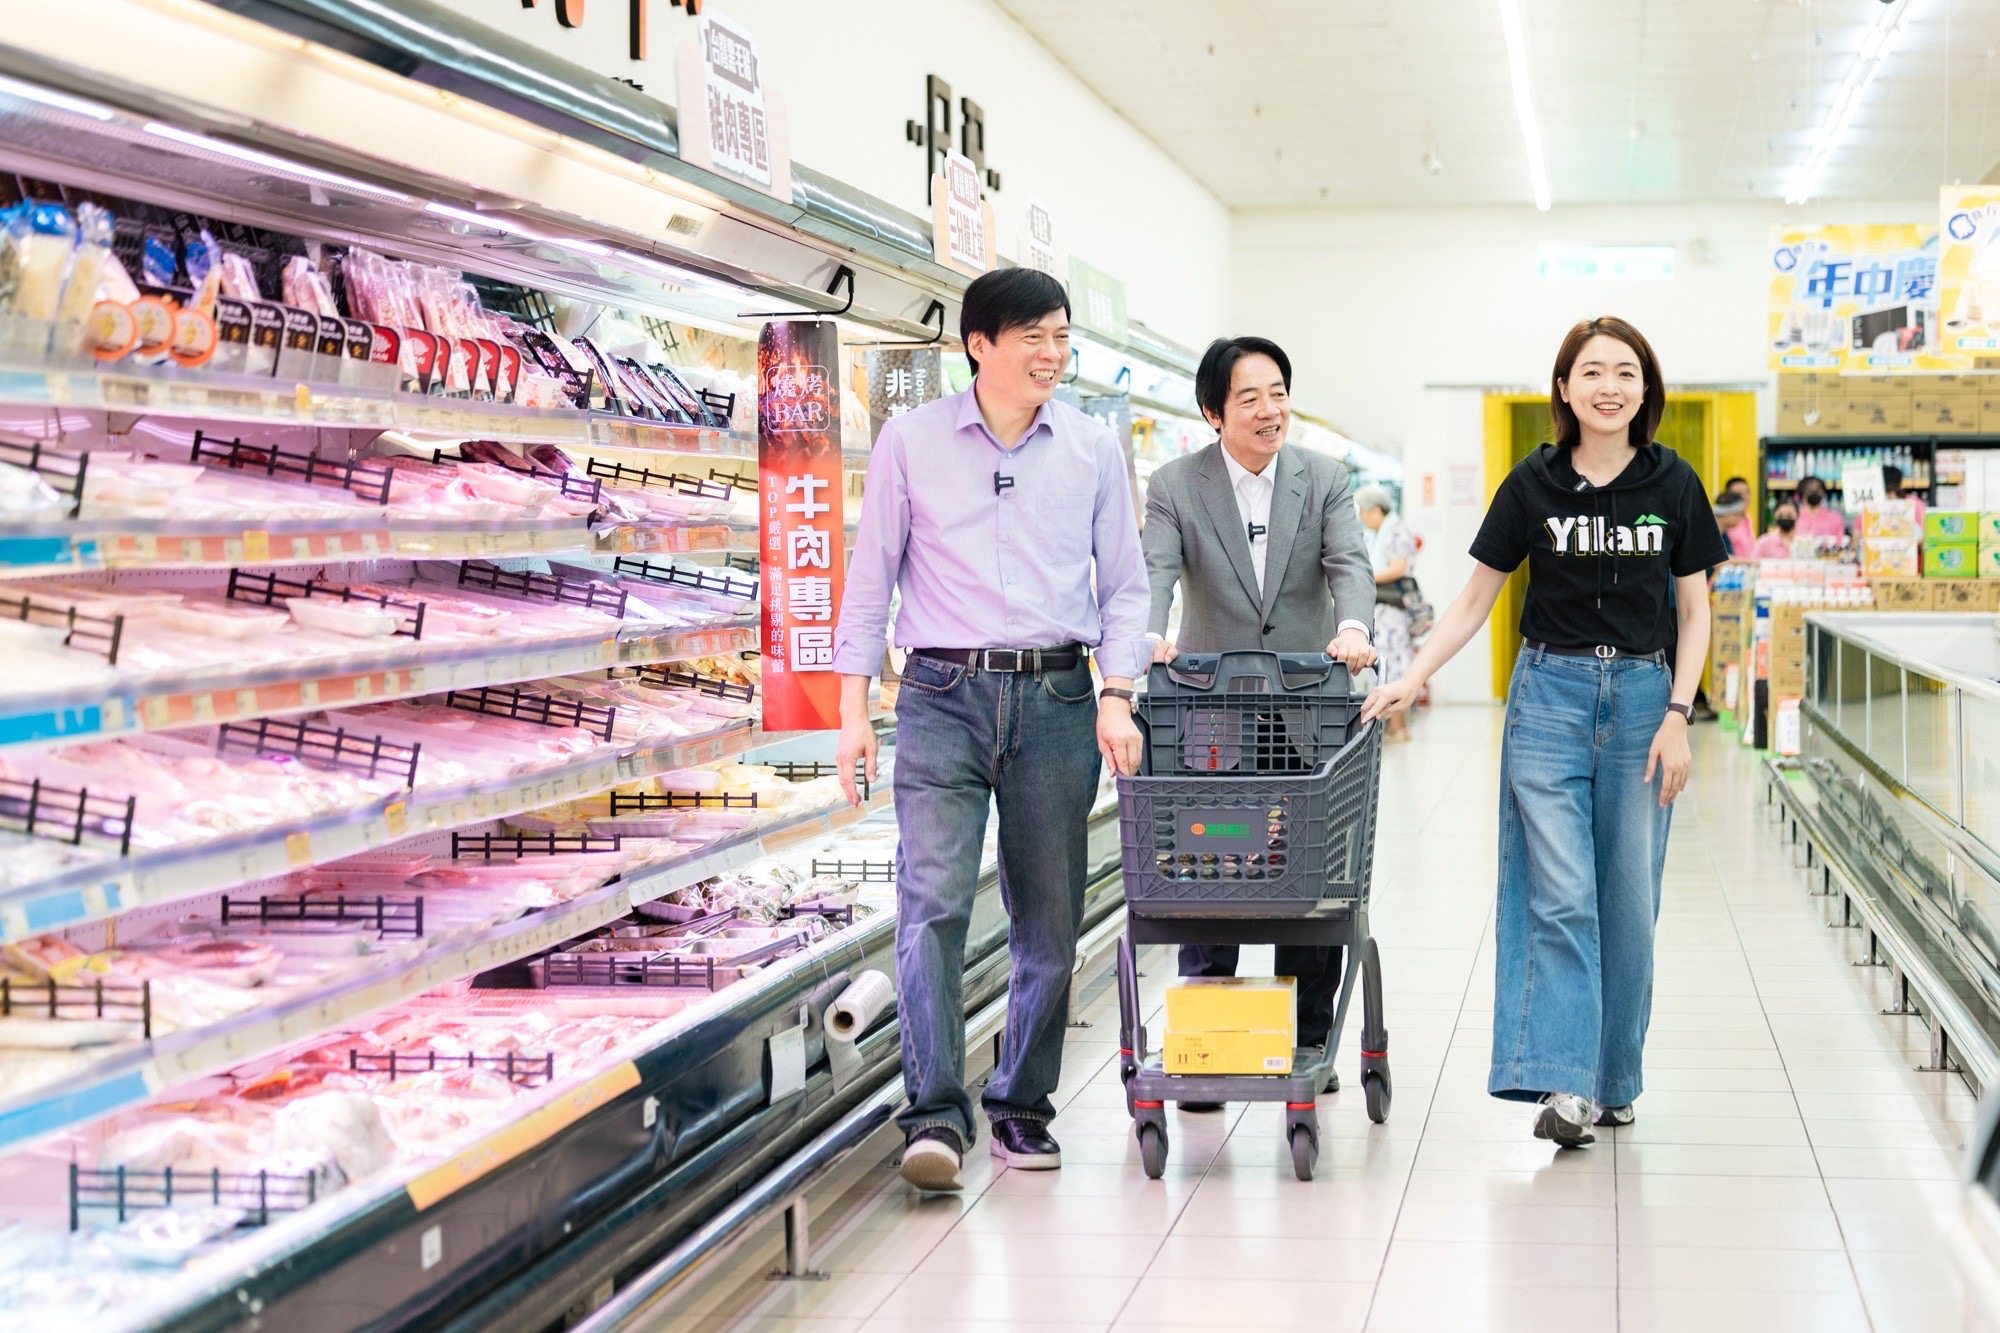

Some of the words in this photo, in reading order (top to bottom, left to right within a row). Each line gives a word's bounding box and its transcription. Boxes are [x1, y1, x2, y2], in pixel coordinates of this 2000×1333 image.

[707, 83, 769, 172] 豬肉專區
[1803, 257, 1936, 308] 年中慶
[773, 373, 823, 399] 燒烤
[915, 368, 927, 407] Non-
[773, 401, 825, 423] BAR
[1545, 515, 1664, 554] Yilan
[785, 473, 834, 672] 牛肉專區
